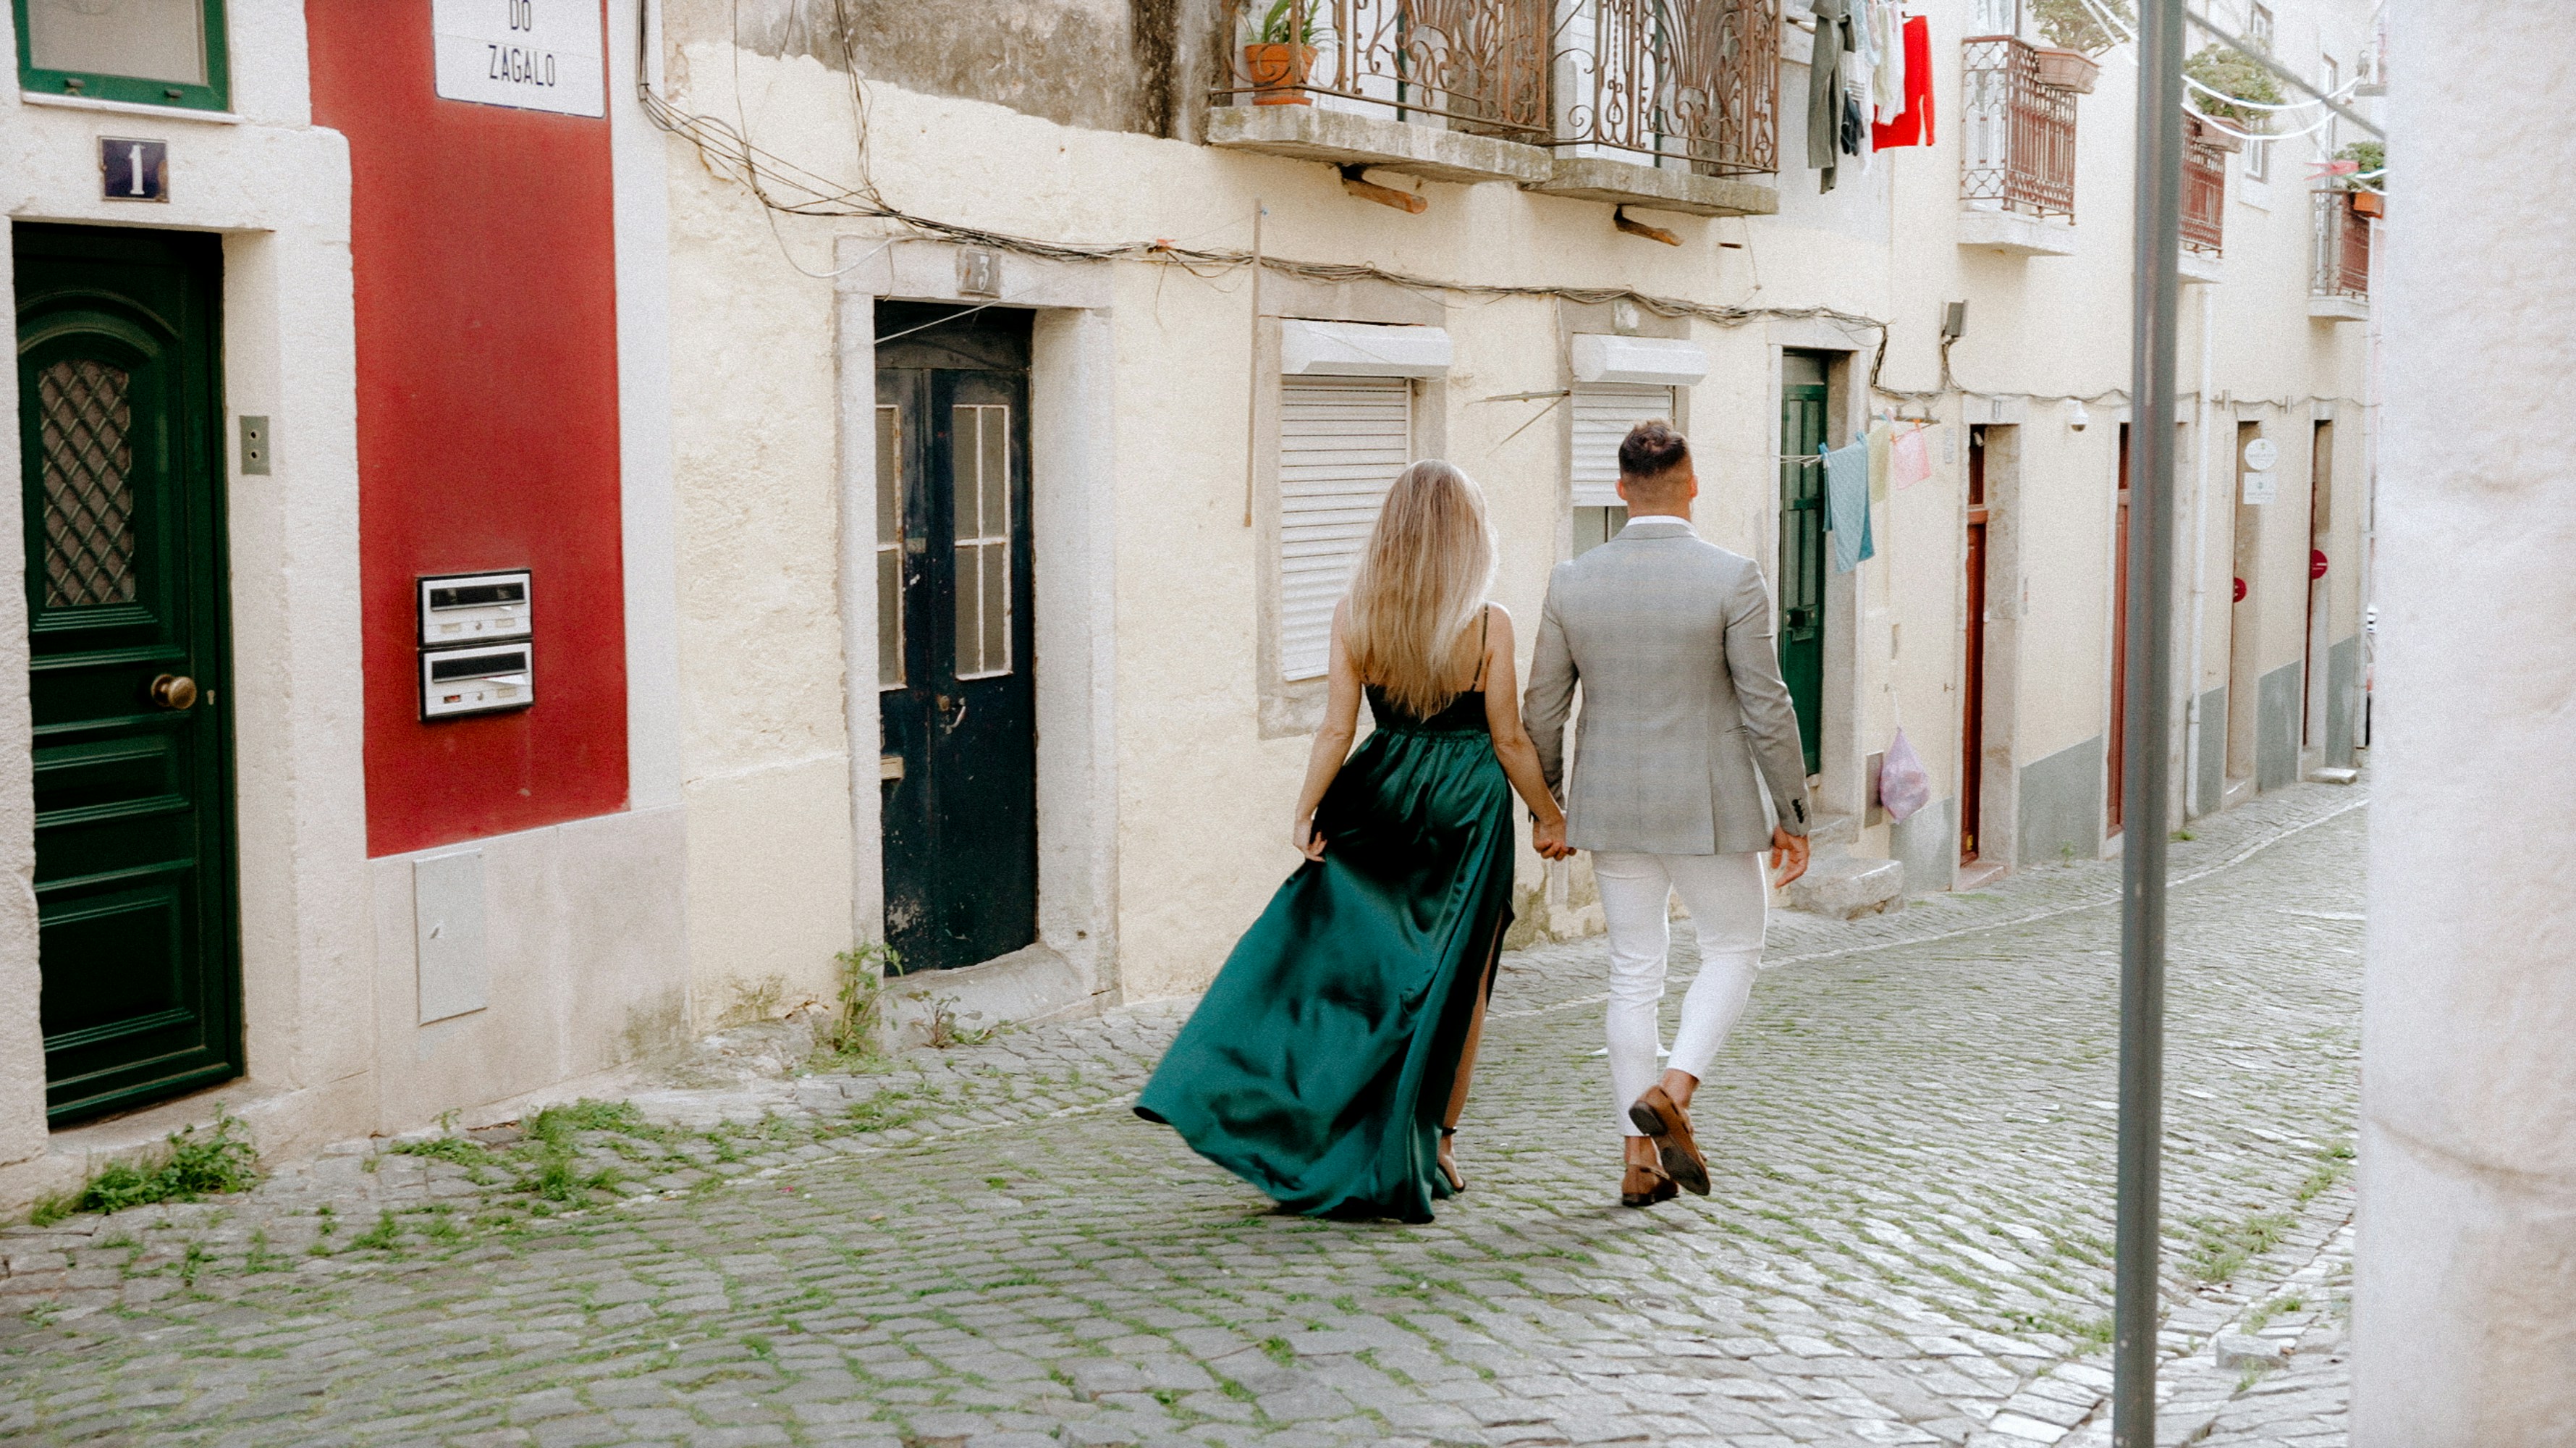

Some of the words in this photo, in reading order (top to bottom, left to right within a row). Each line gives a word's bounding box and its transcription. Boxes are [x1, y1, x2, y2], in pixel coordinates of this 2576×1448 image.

[510, 0, 531, 31] DO
[488, 44, 555, 87] ZAGALO
[129, 144, 145, 195] 1
[978, 255, 990, 290] 3
